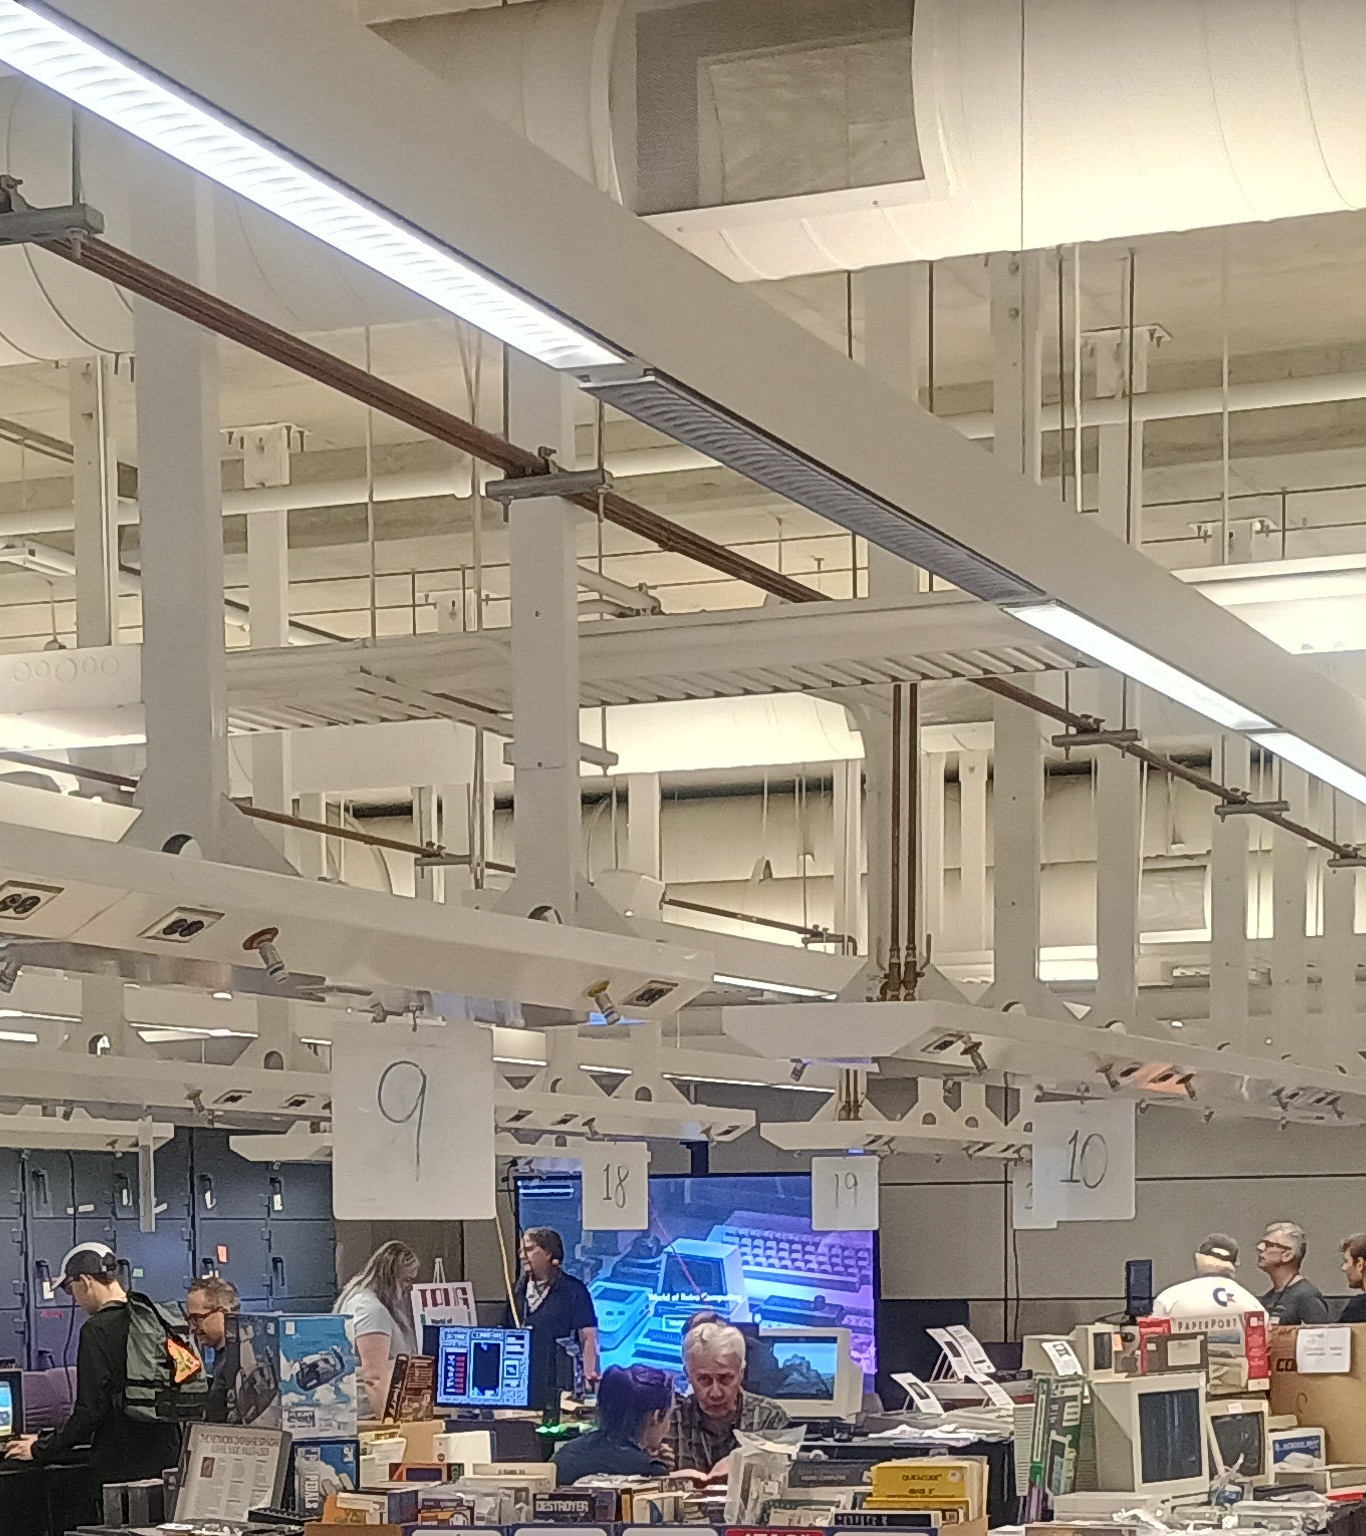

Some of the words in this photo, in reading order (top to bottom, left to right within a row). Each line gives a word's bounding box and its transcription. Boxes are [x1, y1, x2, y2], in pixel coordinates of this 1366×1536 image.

[377, 1060, 427, 1182] 9
[1059, 1129, 1109, 1189] 10
[602, 1163, 630, 1209] 18
[834, 1171, 859, 1209] 19
[535, 1500, 589, 1513] DESTROYER
